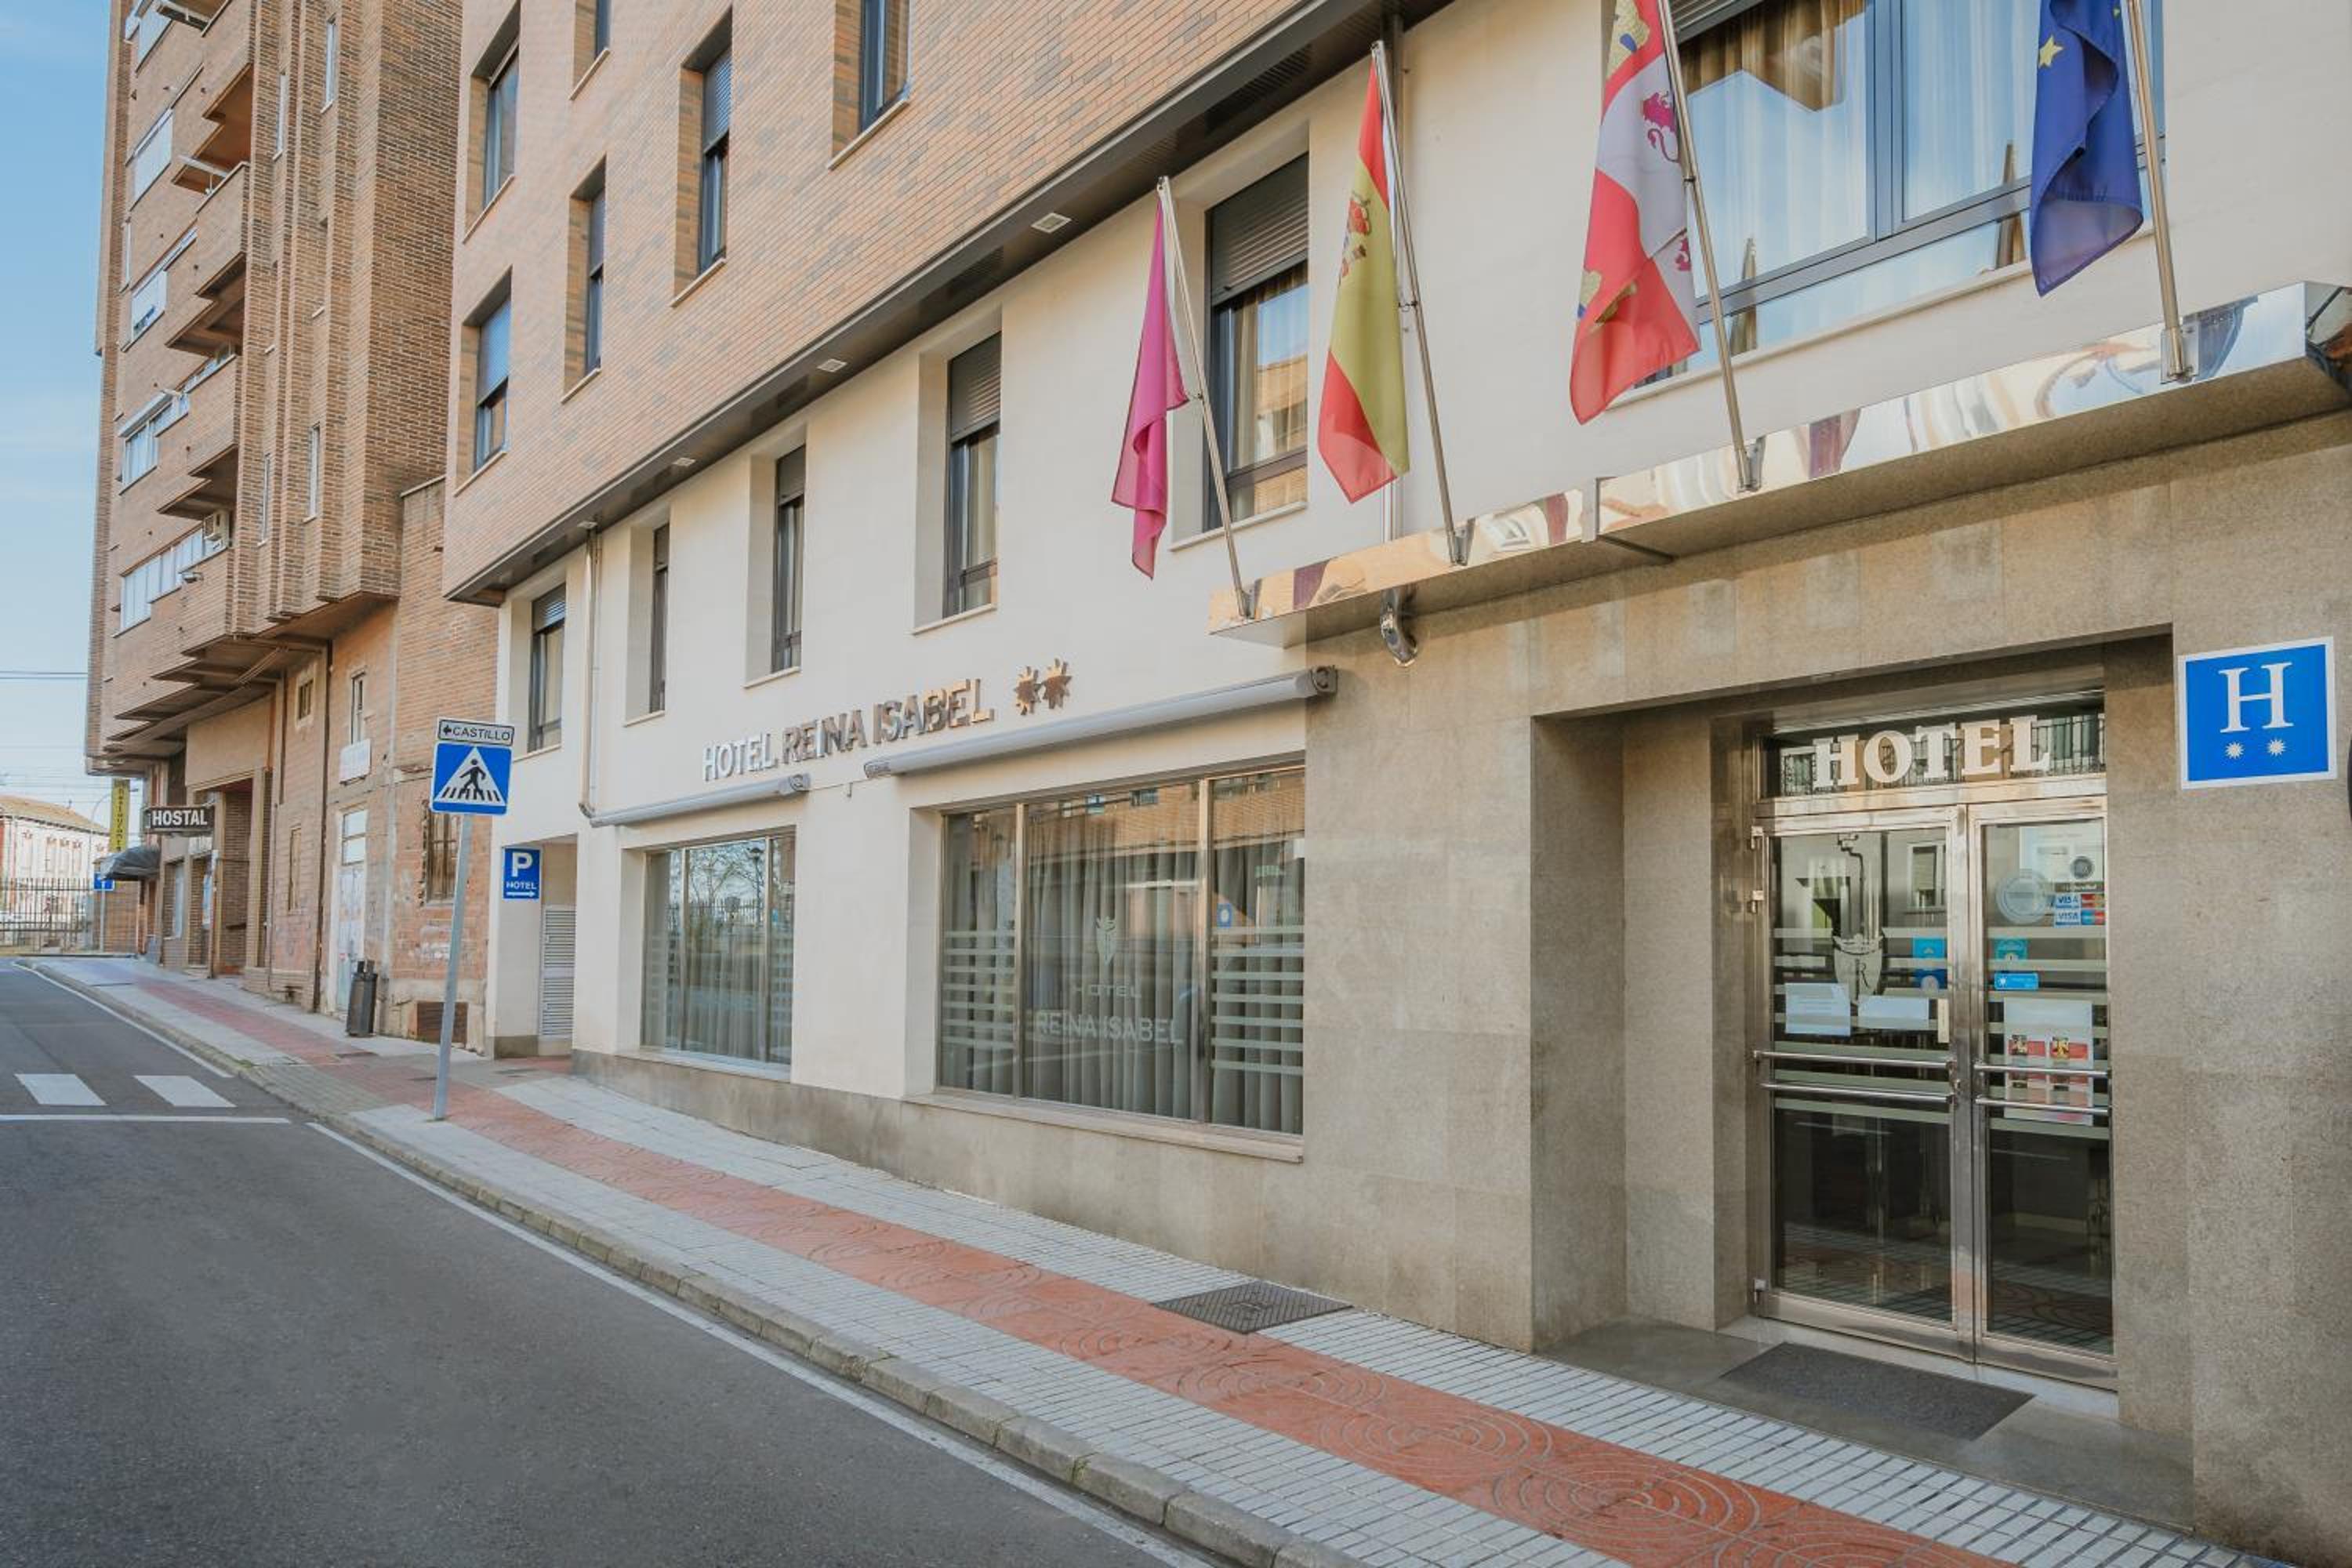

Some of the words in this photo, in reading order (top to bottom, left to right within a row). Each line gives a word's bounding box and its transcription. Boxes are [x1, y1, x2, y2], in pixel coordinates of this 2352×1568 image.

[2218, 662, 2294, 733] H
[452, 726, 510, 742] CASTILLO
[702, 732, 778, 782] HOTEL
[783, 709, 868, 765] REINA
[873, 677, 995, 745] ISABEL
[1811, 714, 2050, 788] HOTEL
[152, 810, 208, 826] HOSTAL
[511, 852, 533, 877] P
[506, 880, 537, 891] HOTEL
[1072, 983, 1142, 999] HOTEL
[1036, 1011, 1097, 1038] REINA
[1100, 1015, 1184, 1044] ISABEL
